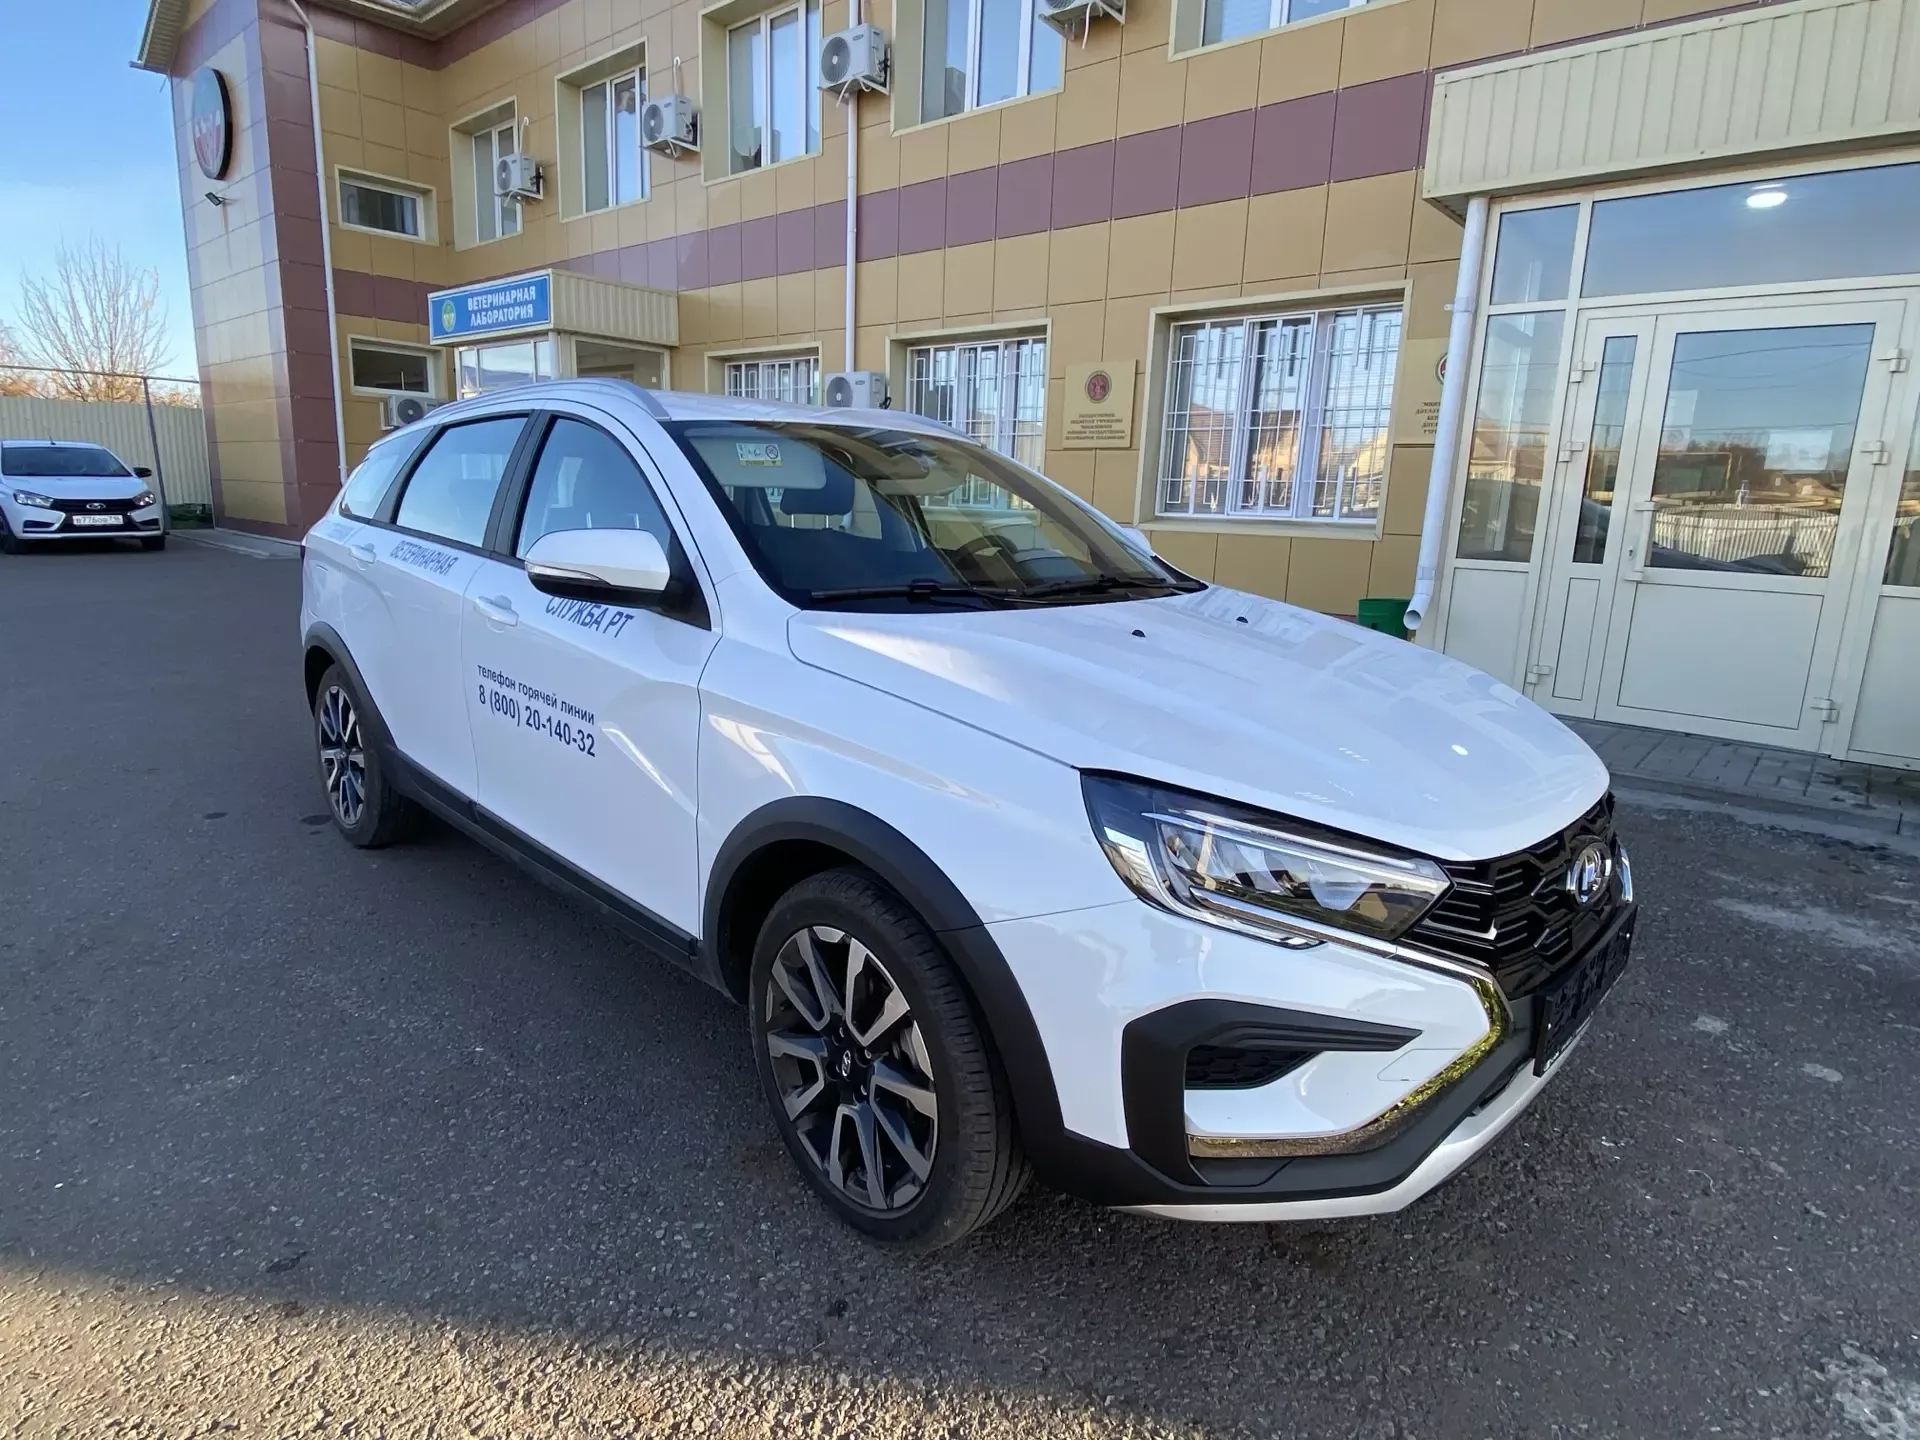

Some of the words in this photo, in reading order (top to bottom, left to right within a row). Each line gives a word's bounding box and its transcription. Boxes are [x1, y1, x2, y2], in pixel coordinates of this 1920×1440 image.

[467, 285, 536, 311] ВЕТЕРИНАРНАЯ
[470, 304, 534, 327] ЛАБОРАТОРИЯ
[389, 540, 459, 577] ВЕТЕРИНАРНАЯ
[545, 596, 610, 632] СЛУЖБА
[602, 610, 636, 638] РТ
[477, 664, 516, 691] телефон
[518, 682, 558, 709] горячей
[560, 700, 595, 726] линии
[479, 684, 486, 705] 8
[490, 688, 521, 728] (800)
[525, 705, 596, 758] 20-140-32
